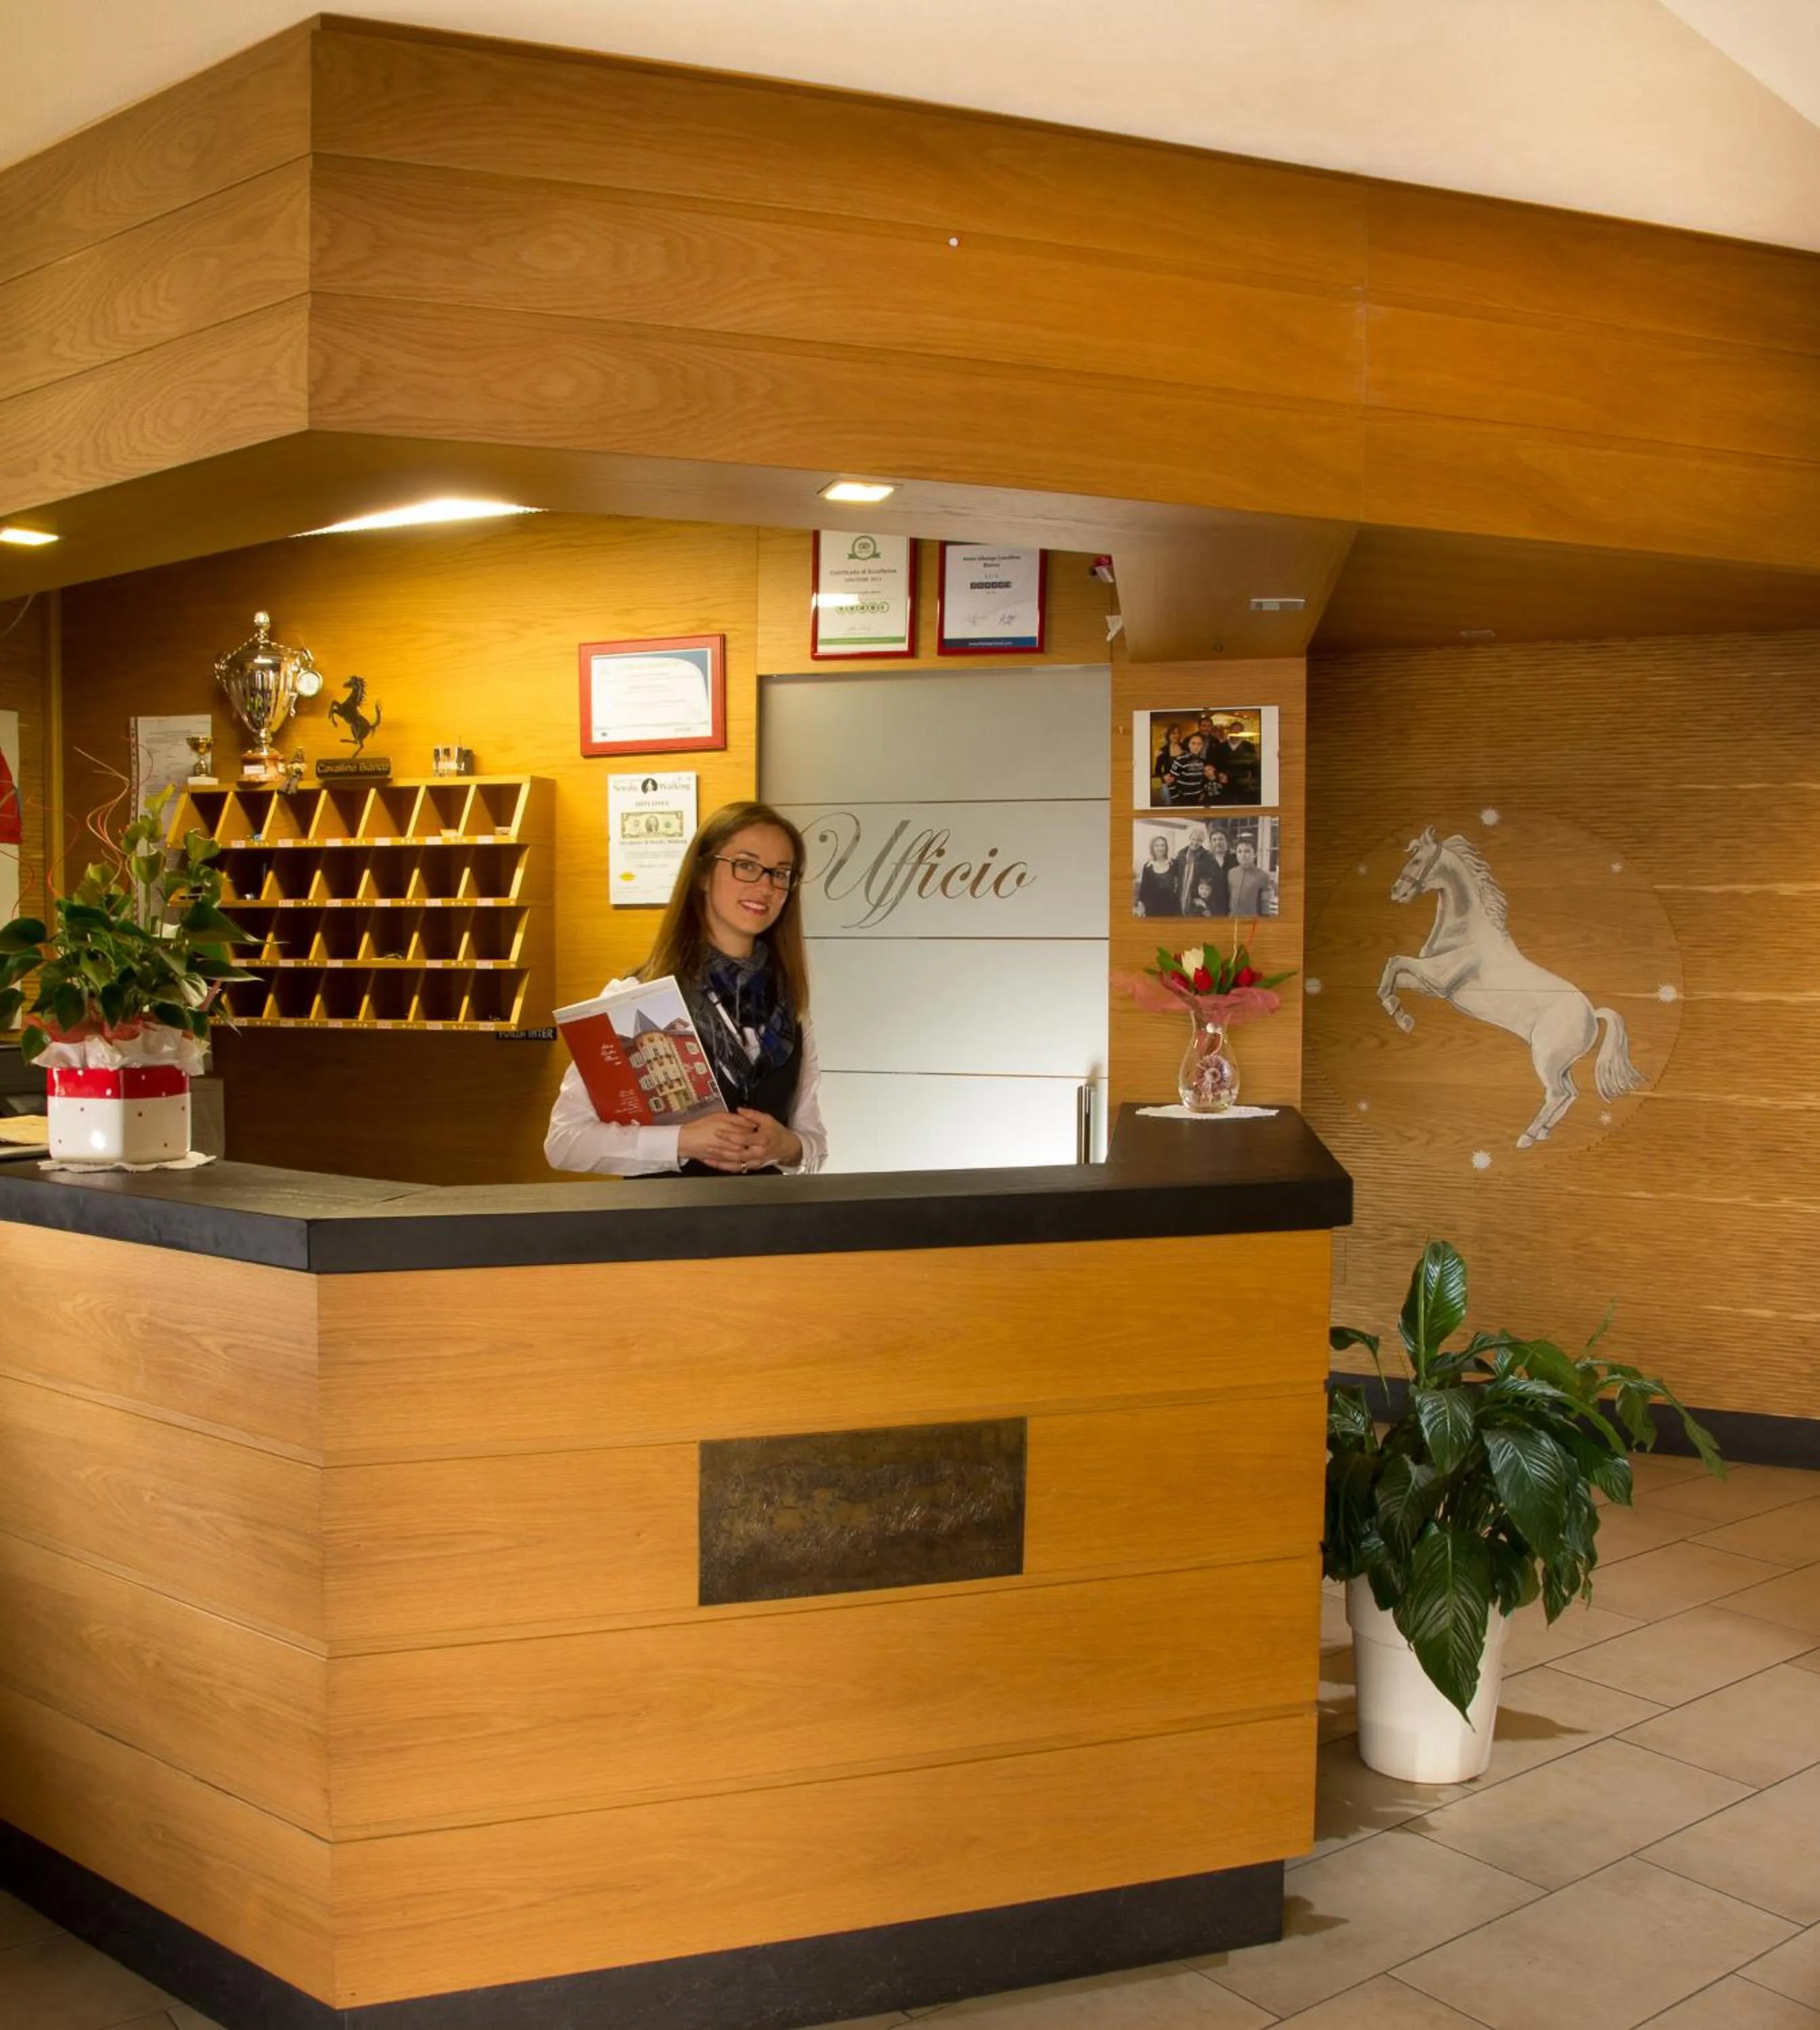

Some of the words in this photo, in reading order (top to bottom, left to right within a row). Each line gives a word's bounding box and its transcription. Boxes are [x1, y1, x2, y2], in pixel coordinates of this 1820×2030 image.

[318, 763, 357, 773] Cavallino
[359, 762, 389, 771] Bianco
[801, 811, 1037, 928] Ufficio
[528, 1028, 553, 1039] INTER
